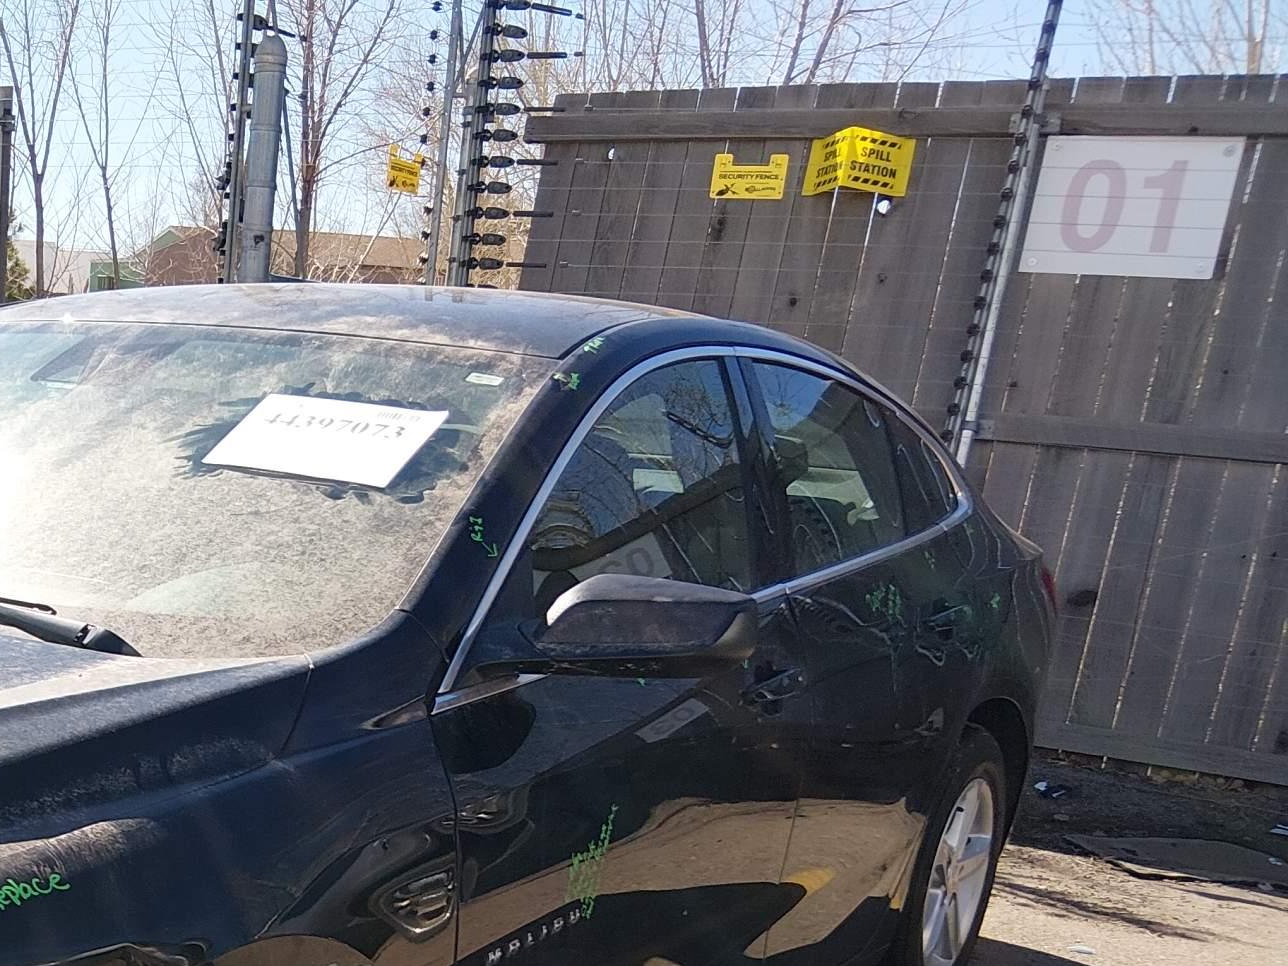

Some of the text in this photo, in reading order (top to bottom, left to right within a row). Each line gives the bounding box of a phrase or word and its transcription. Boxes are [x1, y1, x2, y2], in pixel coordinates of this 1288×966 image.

[860, 146, 892, 162] SPILL
[718, 173, 753, 181] SECURITY
[850, 160, 897, 179] STATION
[1059, 159, 1190, 254] 01
[264, 413, 406, 438] 44397073
